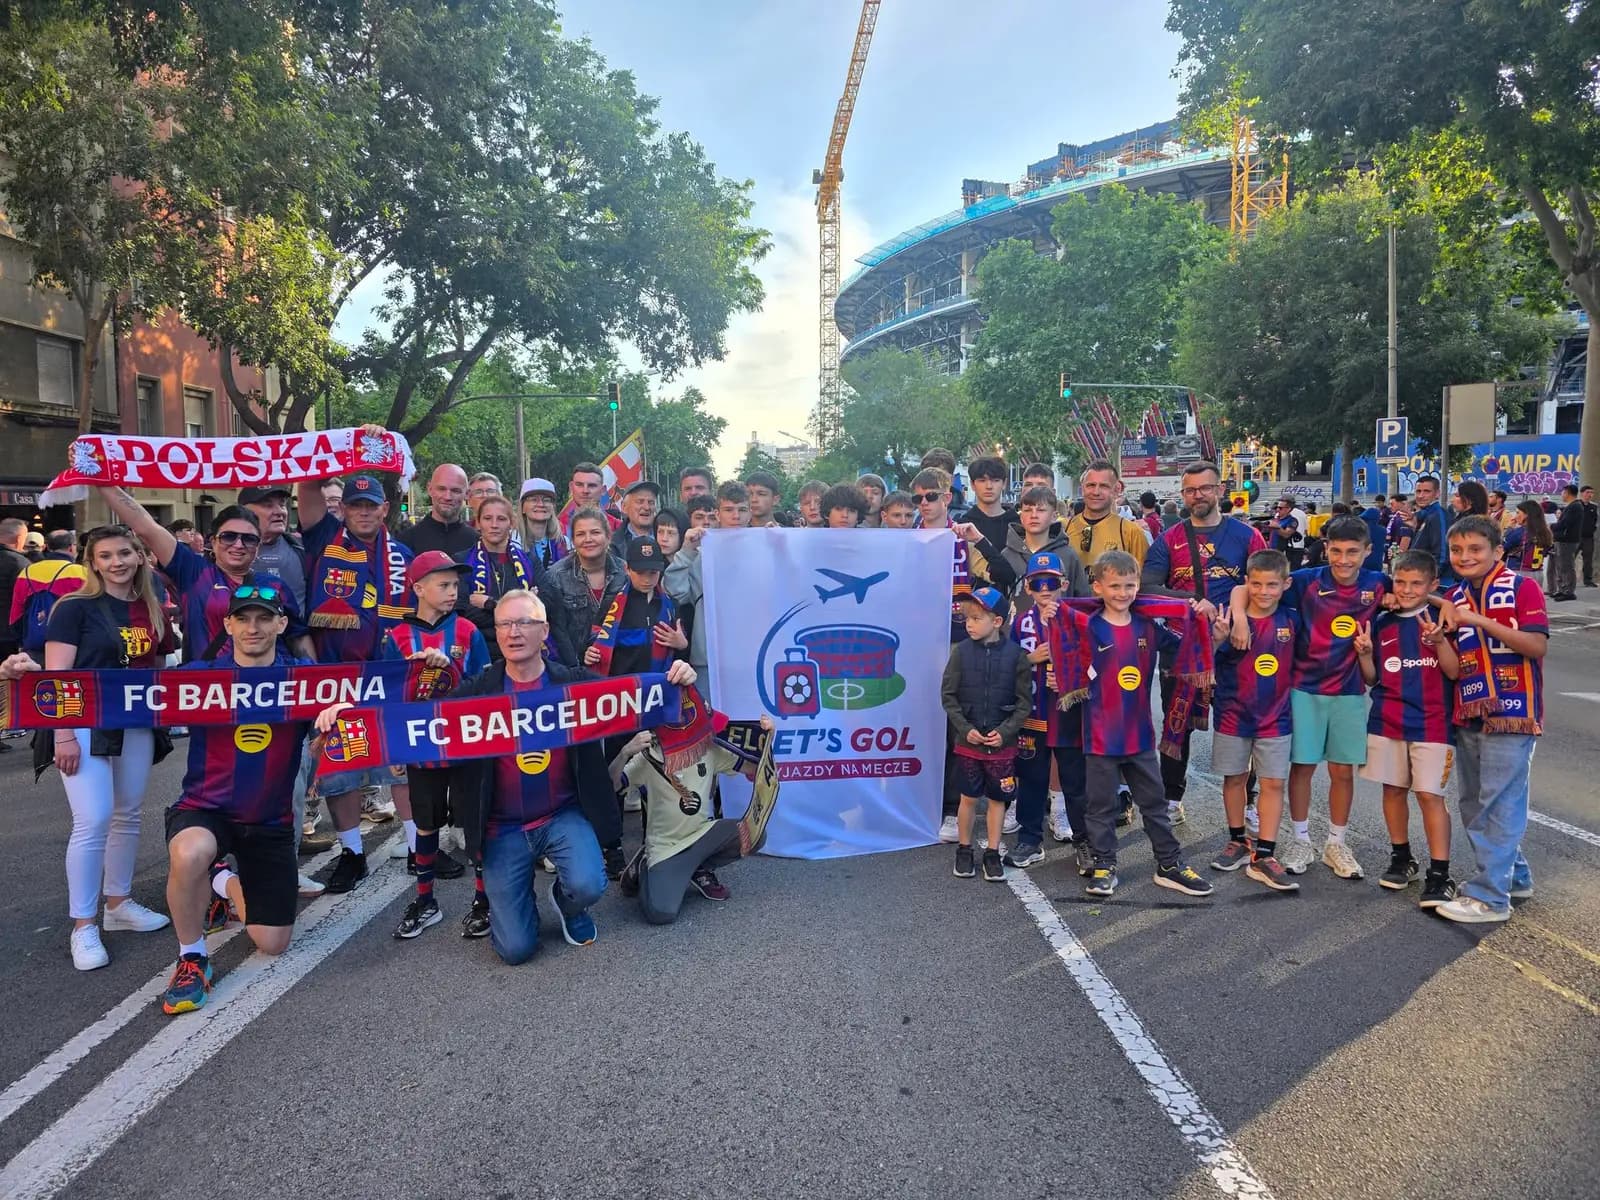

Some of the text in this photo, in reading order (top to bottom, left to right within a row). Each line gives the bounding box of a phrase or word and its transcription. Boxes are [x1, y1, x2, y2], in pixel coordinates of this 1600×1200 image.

[1382, 420, 1402, 443] P
[117, 433, 344, 484] POLSKA
[14, 492, 34, 504] Casa
[1402, 656, 1439, 668] Spotify
[123, 675, 386, 712] FC BARCELONA
[1462, 681, 1484, 696] 1899
[406, 683, 664, 747] FC BARCELONA
[850, 727, 915, 752] GOL
[841, 764, 860, 775] NA
[862, 761, 911, 774] MECZE
